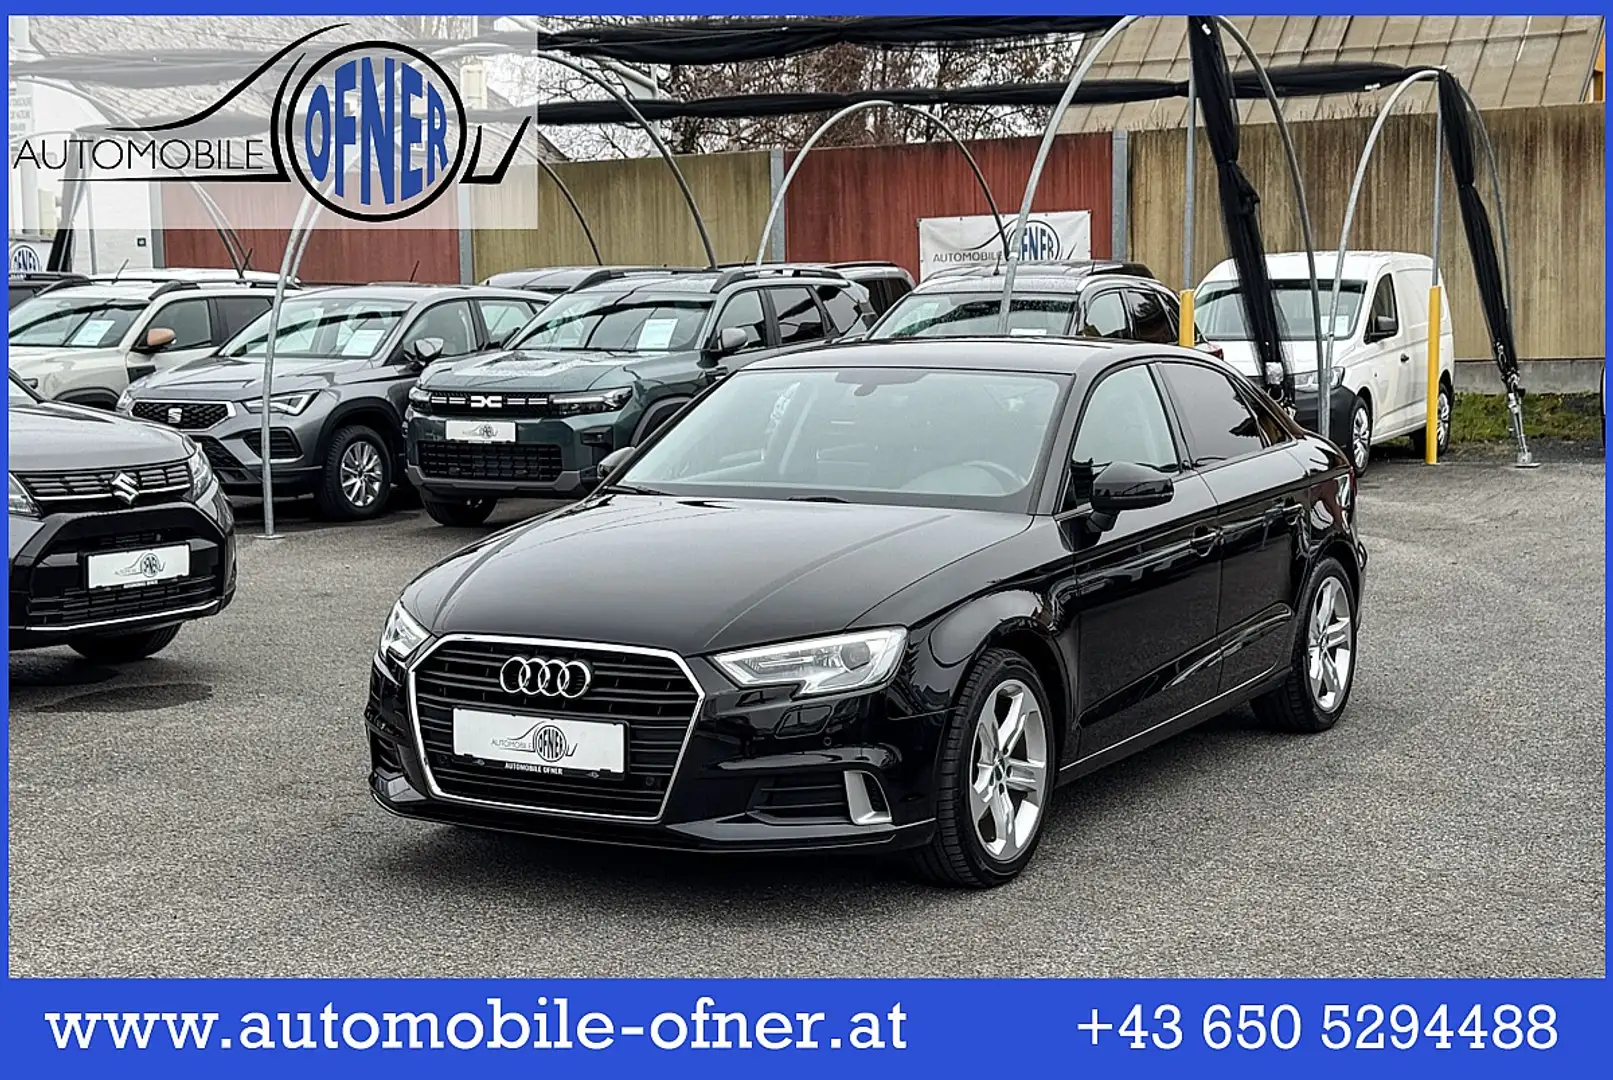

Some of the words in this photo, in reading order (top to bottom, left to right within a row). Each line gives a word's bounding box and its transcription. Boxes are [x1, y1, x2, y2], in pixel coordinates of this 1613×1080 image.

[932, 251, 1003, 263] AUTOMOBILE
[1020, 226, 1054, 260] FNER
[538, 729, 563, 759] OFNER
[504, 762, 541, 772] AUTOMOBILE
[543, 767, 563, 775] OFNER
